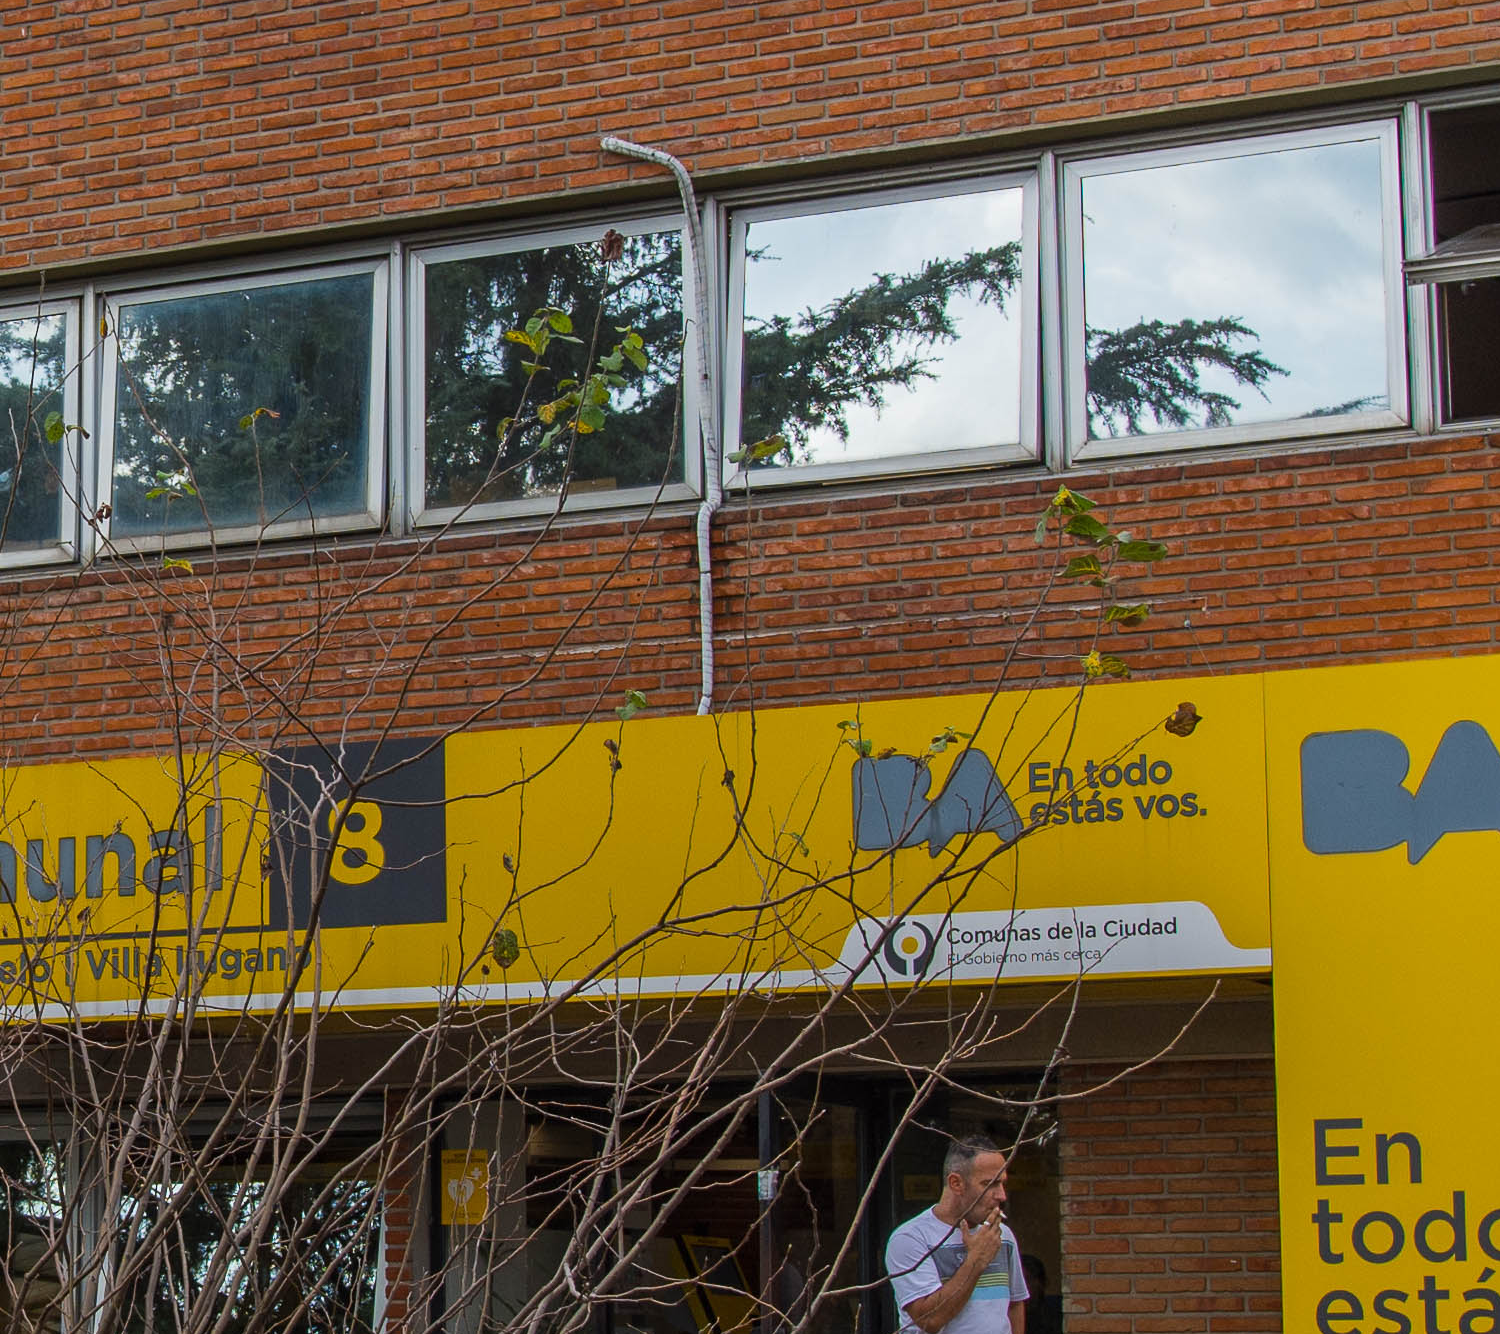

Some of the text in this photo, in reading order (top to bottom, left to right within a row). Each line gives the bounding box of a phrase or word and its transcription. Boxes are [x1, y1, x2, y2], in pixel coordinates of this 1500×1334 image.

[1028, 753, 1173, 793] En todo
[1029, 790, 1208, 825] estás vos.
[328, 798, 386, 886] 8
[946, 916, 1178, 946] Comunas de la Ciudad
[85, 945, 163, 981] Villa
[962, 950, 1028, 966] Gobierno
[1030, 948, 1061, 963] más
[1063, 948, 1102, 963] cerca
[1313, 1117, 1422, 1186] En
